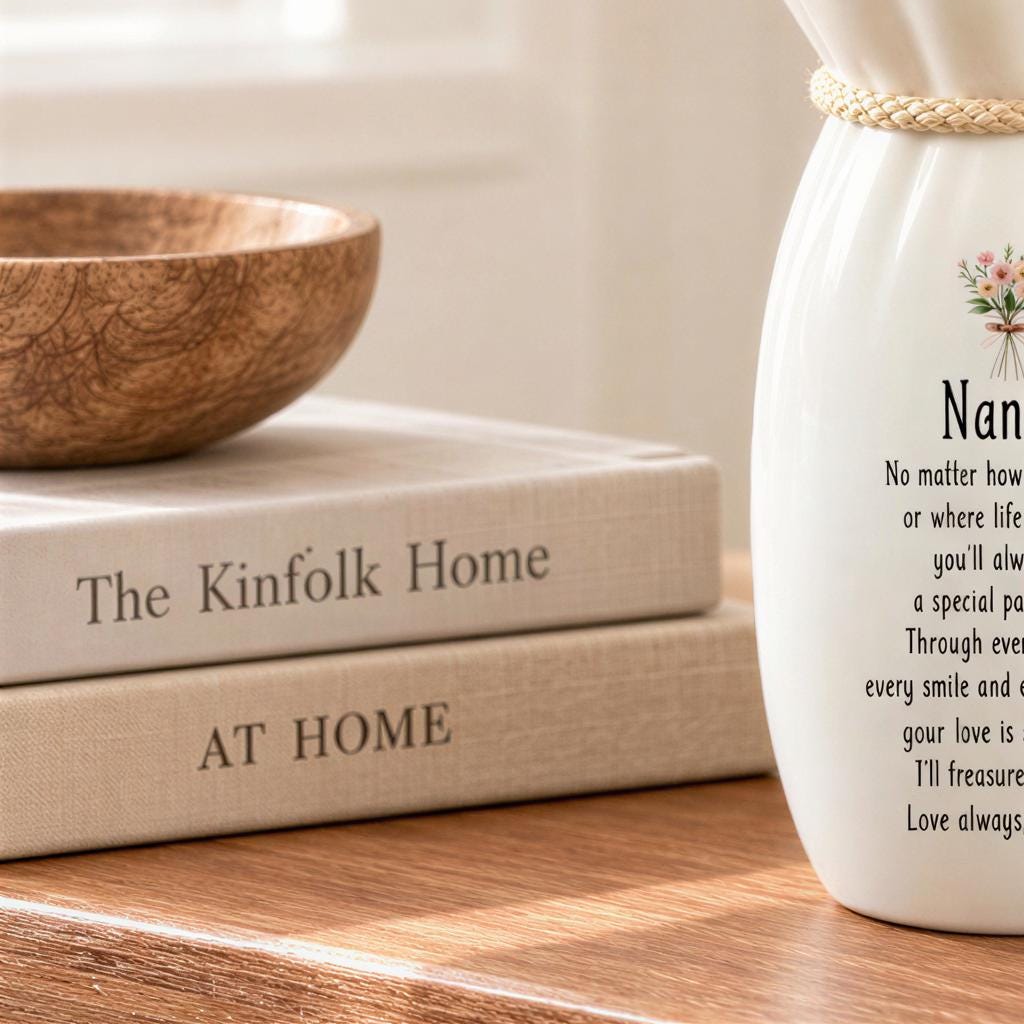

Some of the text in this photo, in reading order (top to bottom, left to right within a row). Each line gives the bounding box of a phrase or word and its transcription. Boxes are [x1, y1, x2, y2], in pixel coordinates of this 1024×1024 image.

[885, 459, 910, 487] No
[918, 459, 978, 487] matter
[986, 459, 1023, 487] how
[903, 510, 922, 529] or
[930, 501, 985, 529] where
[994, 500, 1022, 529] life
[933, 543, 983, 580] you'll
[76, 540, 551, 626] The Kinfolk Home
[913, 594, 924, 613] a
[932, 585, 994, 621] special
[905, 626, 983, 664] Through
[865, 679, 914, 707] every
[922, 671, 970, 698] smile
[977, 670, 1011, 698] and
[197, 701, 453, 772] AT HOME
[955, 716, 991, 744] love
[1000, 720, 1014, 744] is
[907, 803, 950, 832] Love
